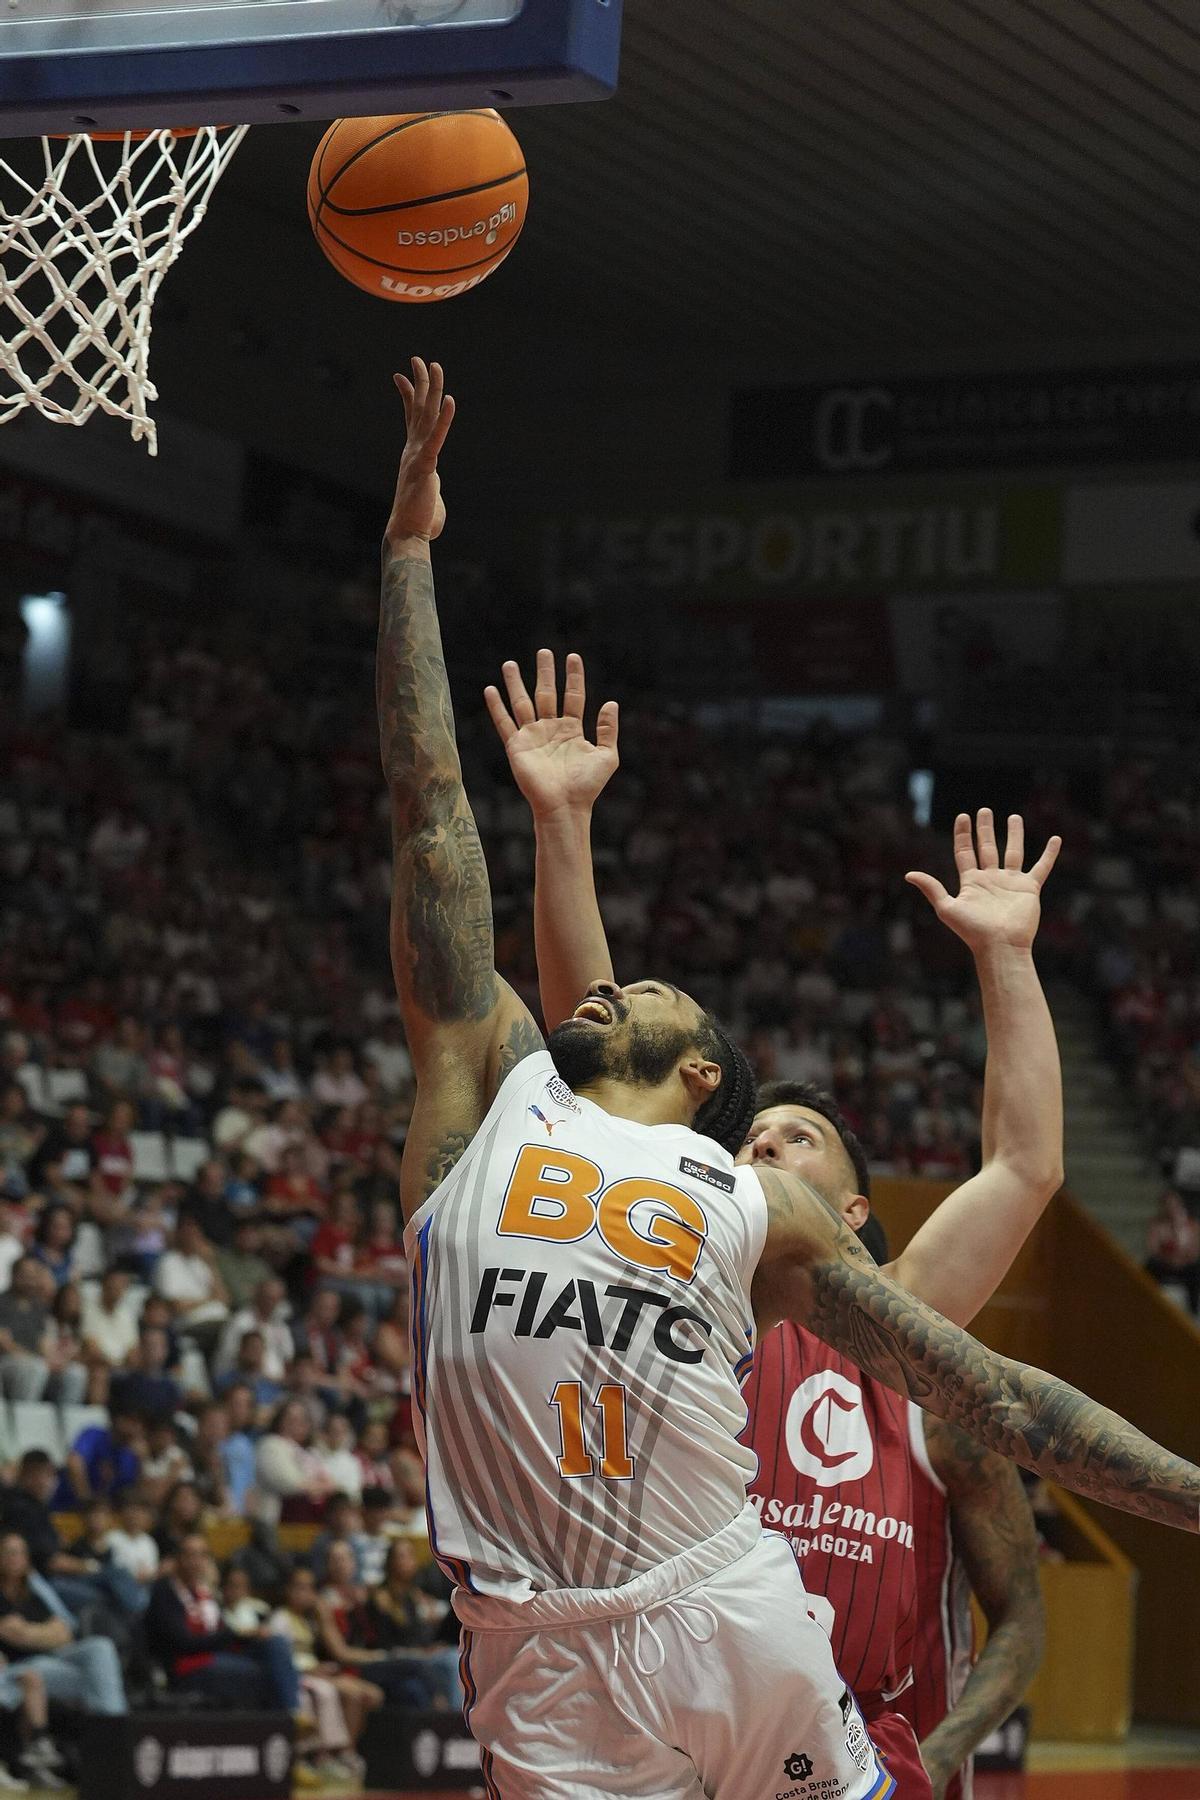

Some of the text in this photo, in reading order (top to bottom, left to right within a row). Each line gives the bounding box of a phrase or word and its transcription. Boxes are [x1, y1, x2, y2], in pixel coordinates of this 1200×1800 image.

[398, 202, 516, 247] liga endesa
[683, 1167, 732, 1192] endesa
[684, 1160, 707, 1175] liga
[497, 1143, 708, 1285] BG
[470, 1267, 713, 1364] FIATC
[548, 1381, 635, 1480] 11
[775, 1778, 839, 1800] Costa Brava
